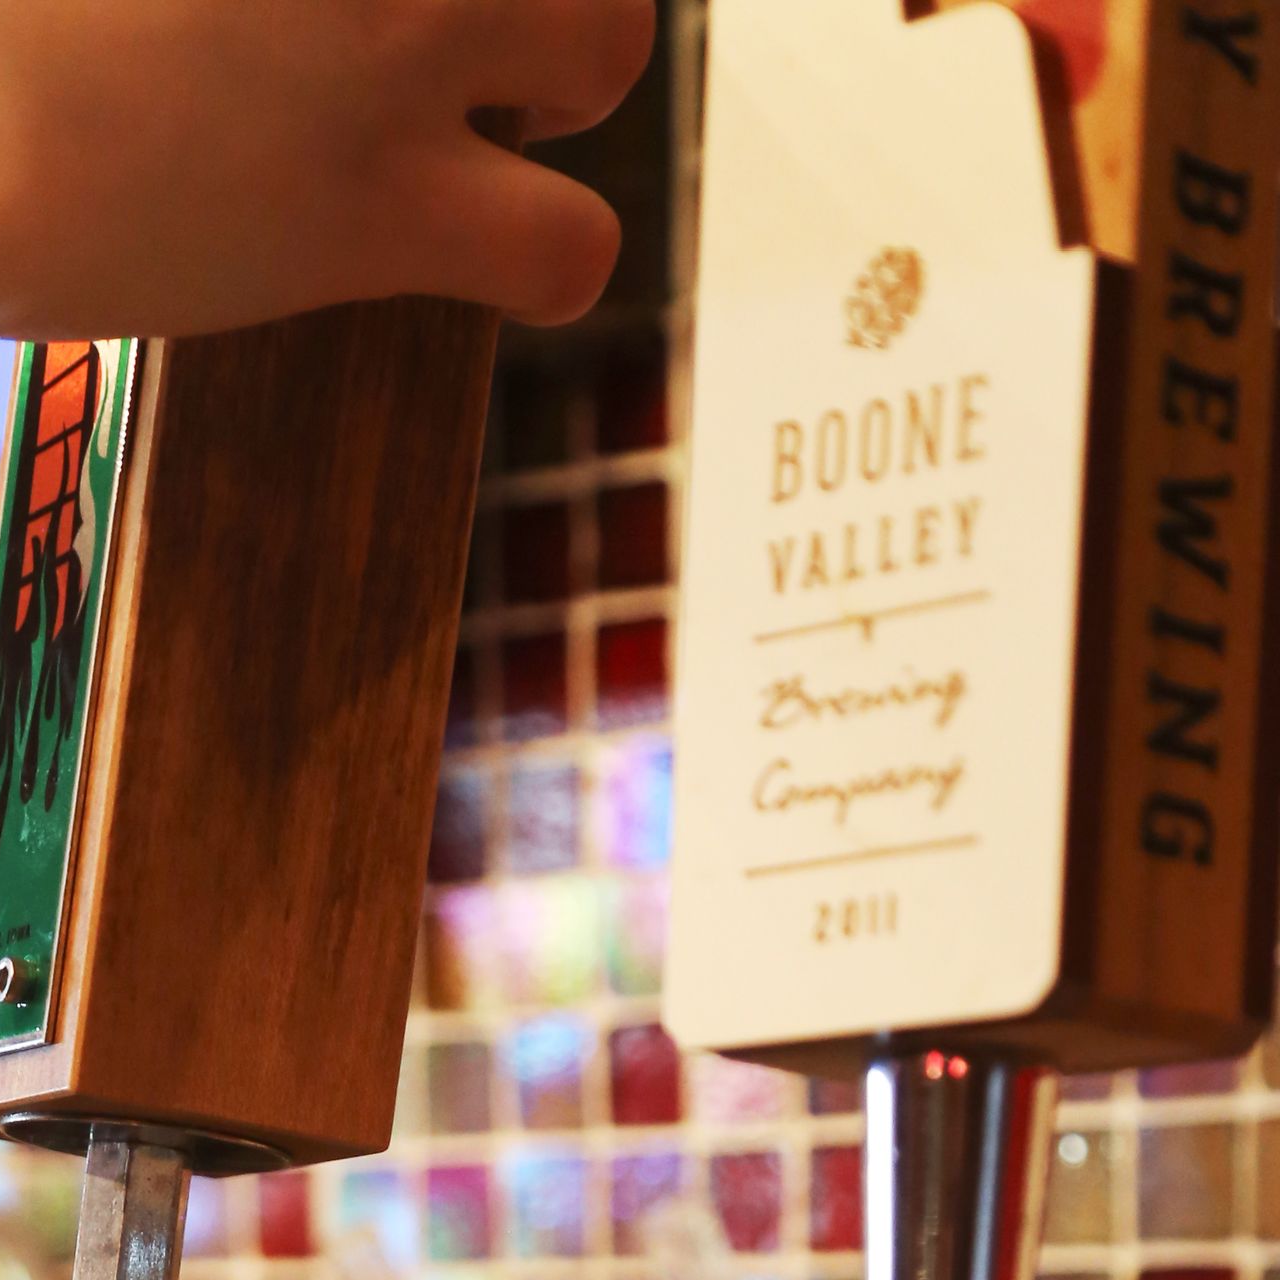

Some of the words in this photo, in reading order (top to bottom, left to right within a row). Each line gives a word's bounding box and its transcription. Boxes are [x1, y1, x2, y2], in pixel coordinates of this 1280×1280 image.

[769, 373, 994, 505] BOONE
[767, 497, 982, 596] VALLEY
[1138, 147, 1254, 868] BREWING
[759, 663, 966, 732] Brewing
[751, 756, 967, 828] Company
[815, 891, 899, 943] 2011
